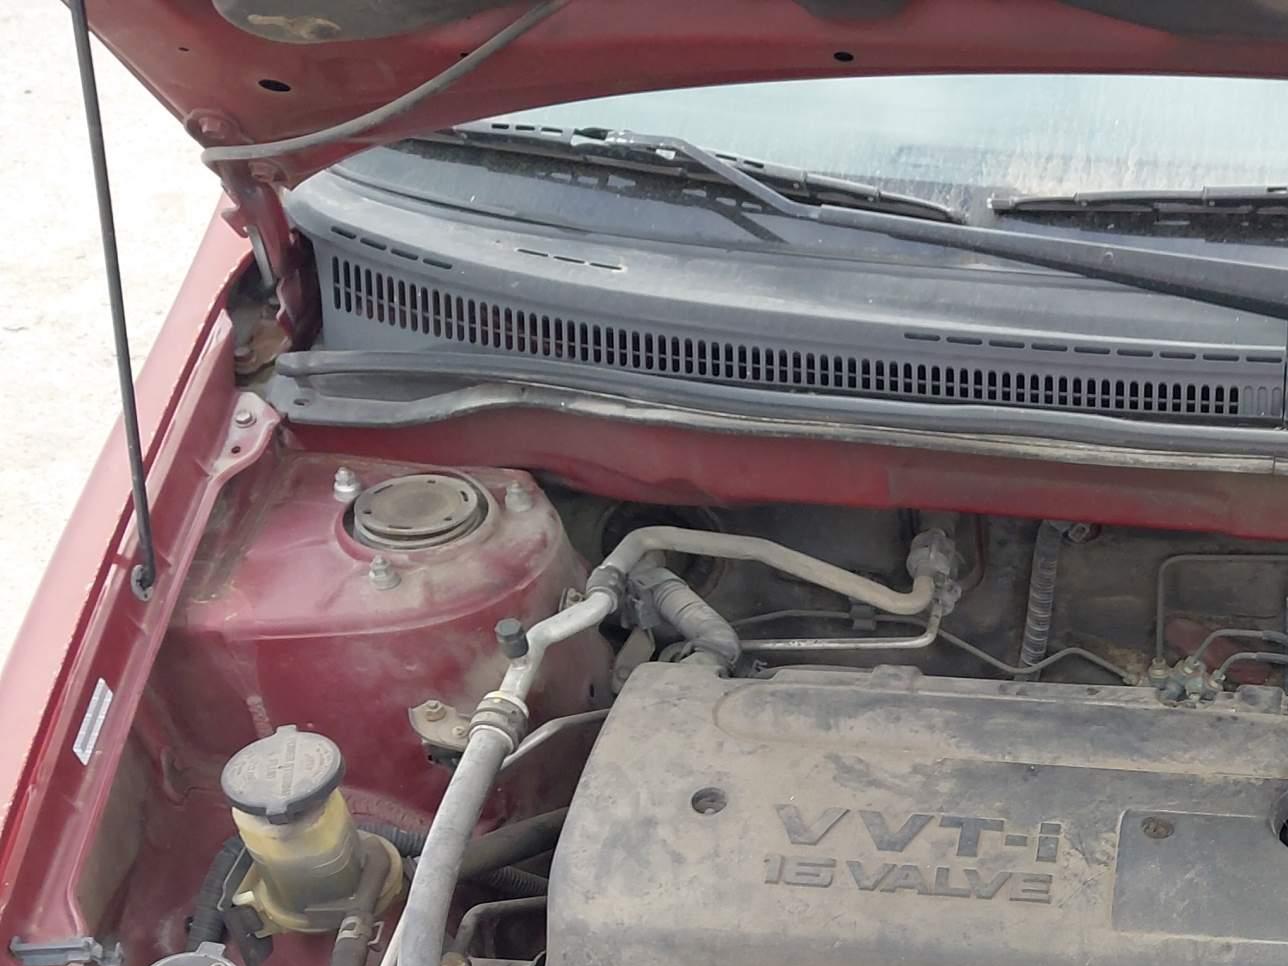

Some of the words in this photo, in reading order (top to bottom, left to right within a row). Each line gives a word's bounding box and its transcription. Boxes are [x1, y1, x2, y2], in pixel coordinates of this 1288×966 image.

[775, 804, 1062, 862] VVT-i
[764, 855, 837, 888] 16
[846, 860, 1053, 904] VALVE
